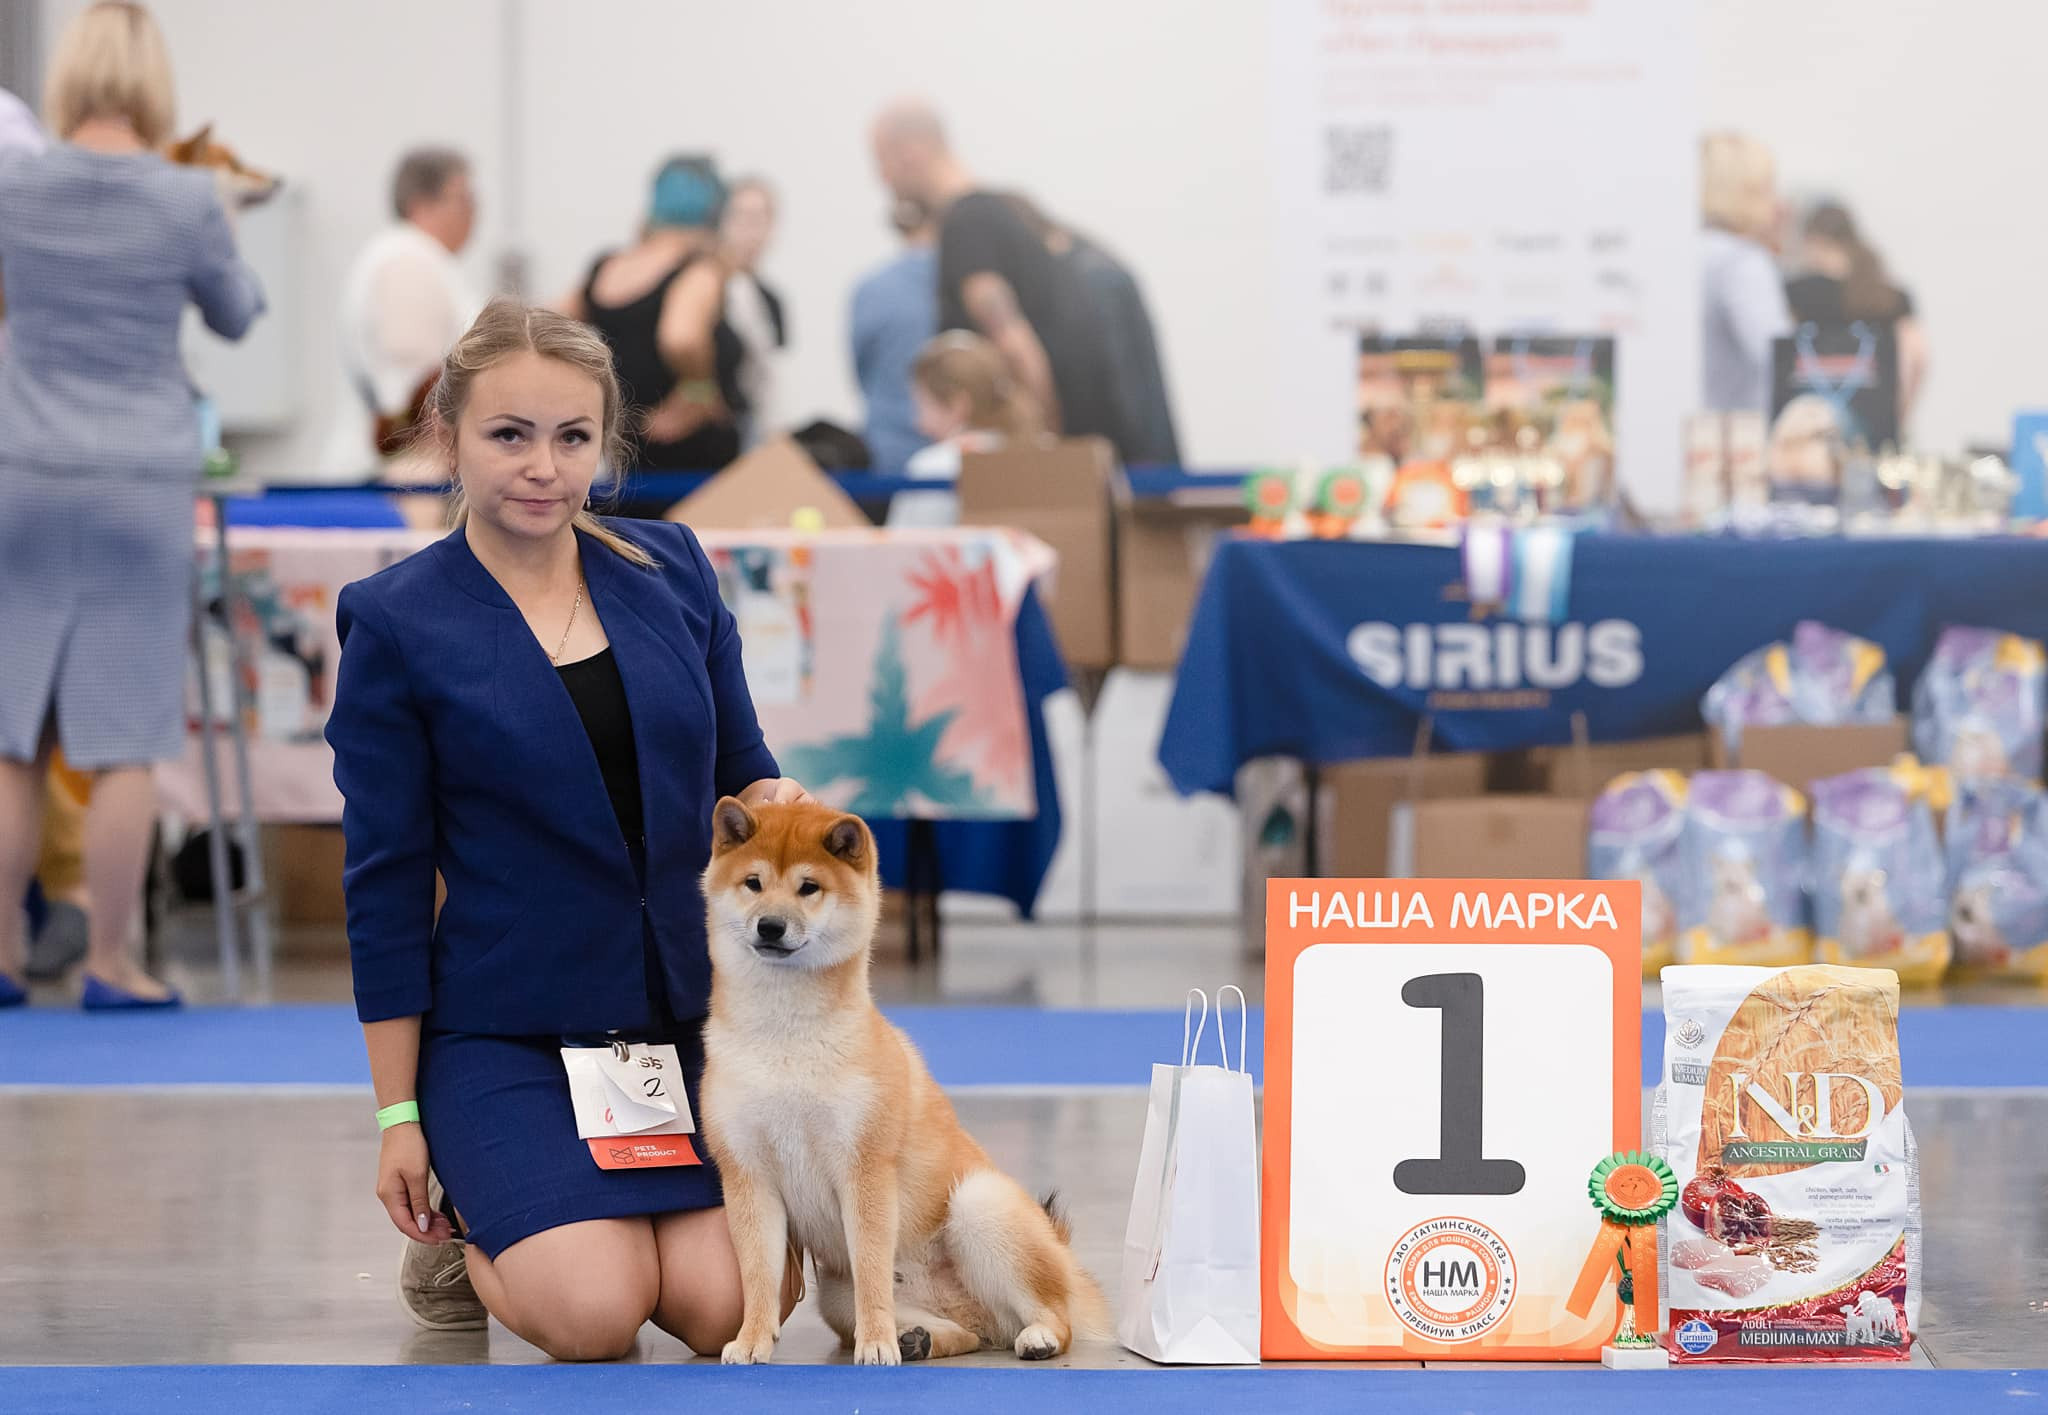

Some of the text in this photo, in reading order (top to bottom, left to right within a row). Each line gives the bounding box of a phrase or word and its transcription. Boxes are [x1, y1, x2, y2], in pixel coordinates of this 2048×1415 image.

[1347, 619, 1644, 689] SIRIUS
[1290, 891, 1618, 930] НАША МАРКА
[643, 1077, 665, 1097] 2
[1393, 972, 1526, 1195] 1
[1727, 1072, 1885, 1139] N&D
[636, 1149, 677, 1157] PRODUCT
[1729, 1146, 1863, 1159] ANCESTRAL GRAIN
[1392, 1221, 1507, 1265] ЗАО «ГАТЧИНСКИЙ ККЗ»
[1407, 1249, 1422, 1272] КОРМ
[1422, 1238, 1439, 1251] ДЛЯ
[1440, 1236, 1471, 1246] КОШЕК
[1478, 1247, 1496, 1273] СОБАК
[1423, 1260, 1479, 1288] НМ
[1408, 1291, 1493, 1321] ЕЖЕДНЕВНЫЙ РАЦИОН
[1402, 1310, 1496, 1337] ПРЕМИУМ КЛАСС
[1679, 1332, 1713, 1342] Farmina
[1742, 1320, 1772, 1329] ADULT
